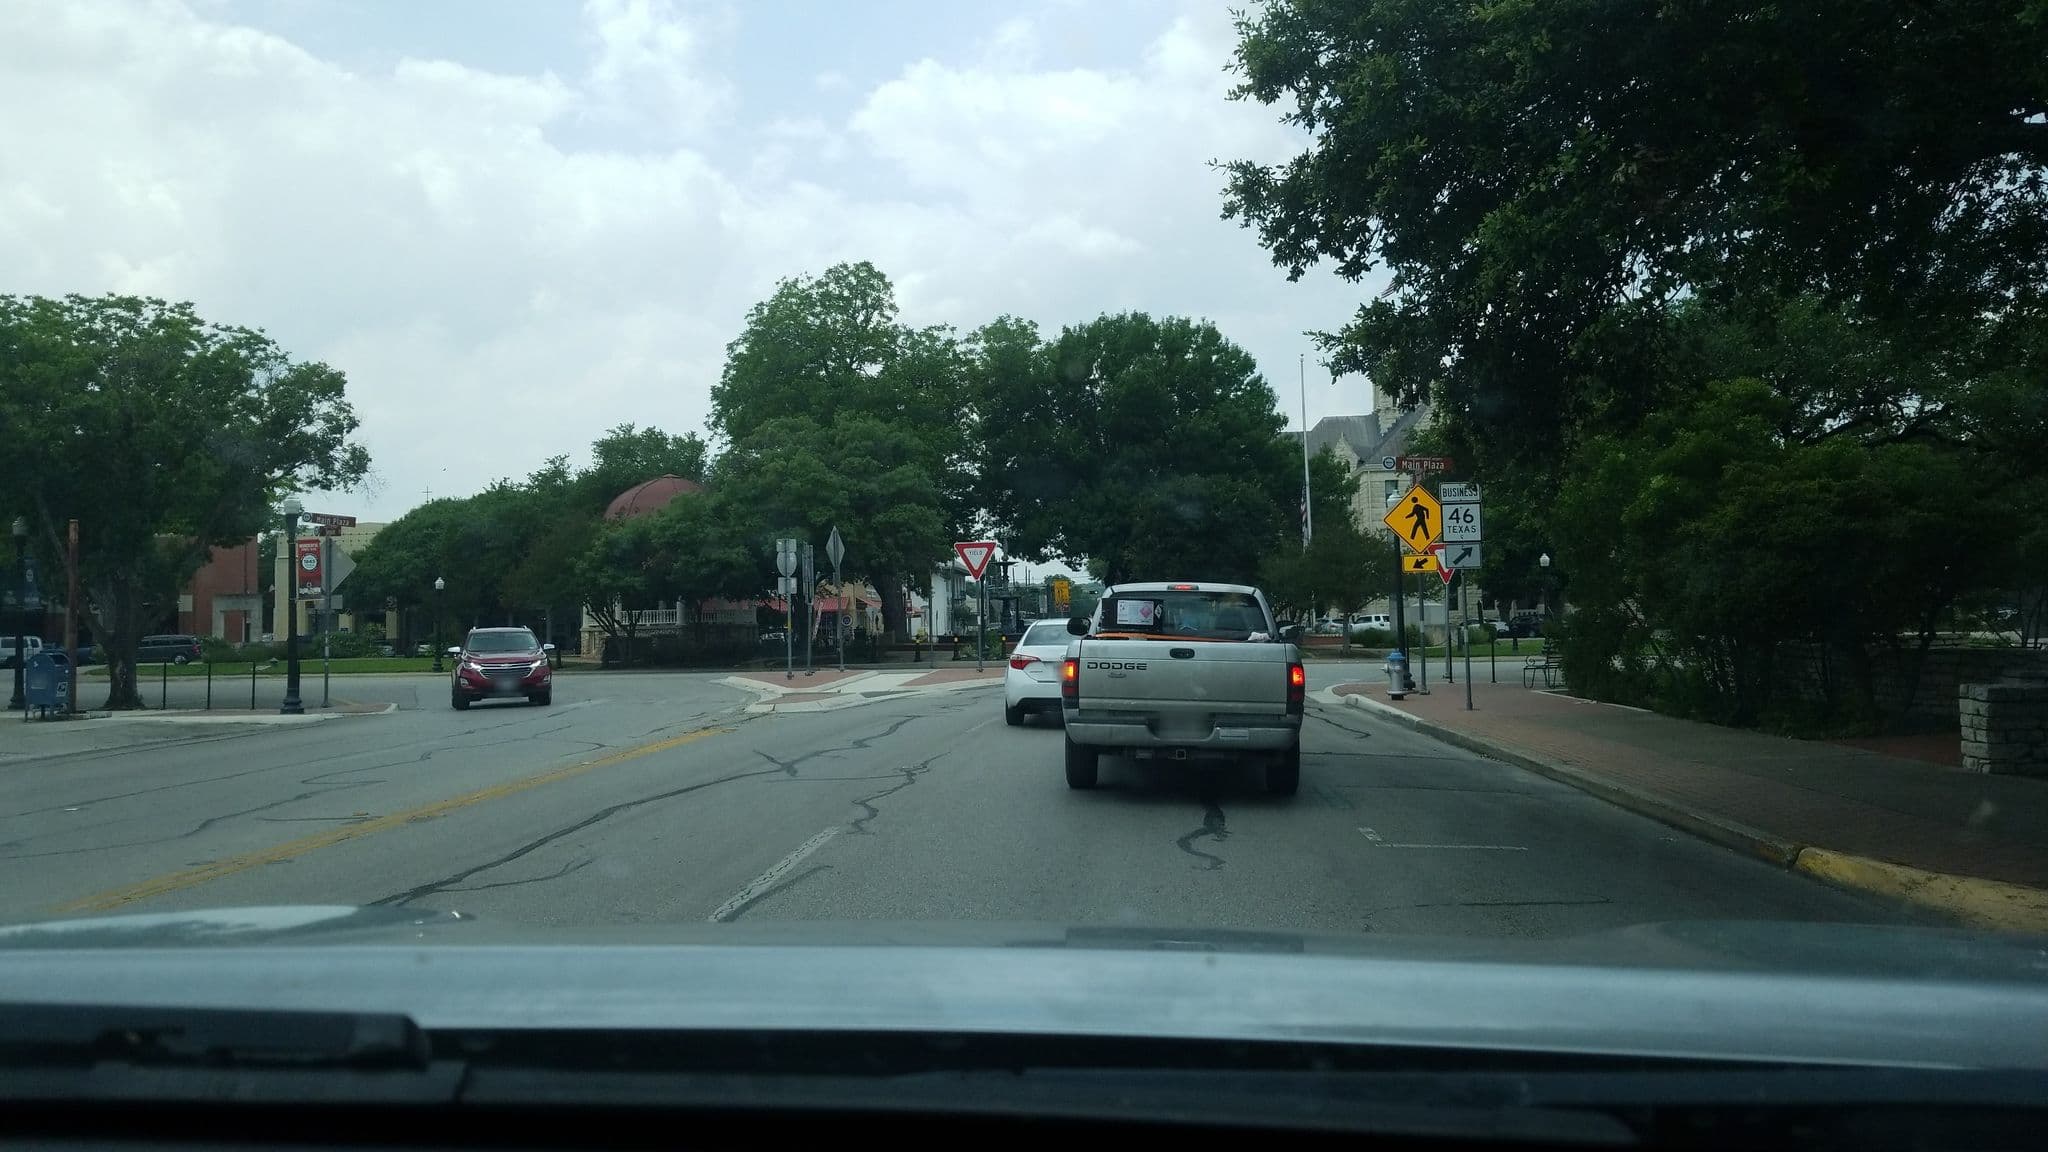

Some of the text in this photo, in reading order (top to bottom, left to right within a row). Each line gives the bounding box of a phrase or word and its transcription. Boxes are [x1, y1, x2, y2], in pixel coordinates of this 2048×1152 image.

[1402, 460, 1445, 470] Main Plaza
[1448, 508, 1474, 524] 46
[1447, 525, 1477, 533] TEXAS
[1086, 661, 1148, 671] DODGE
